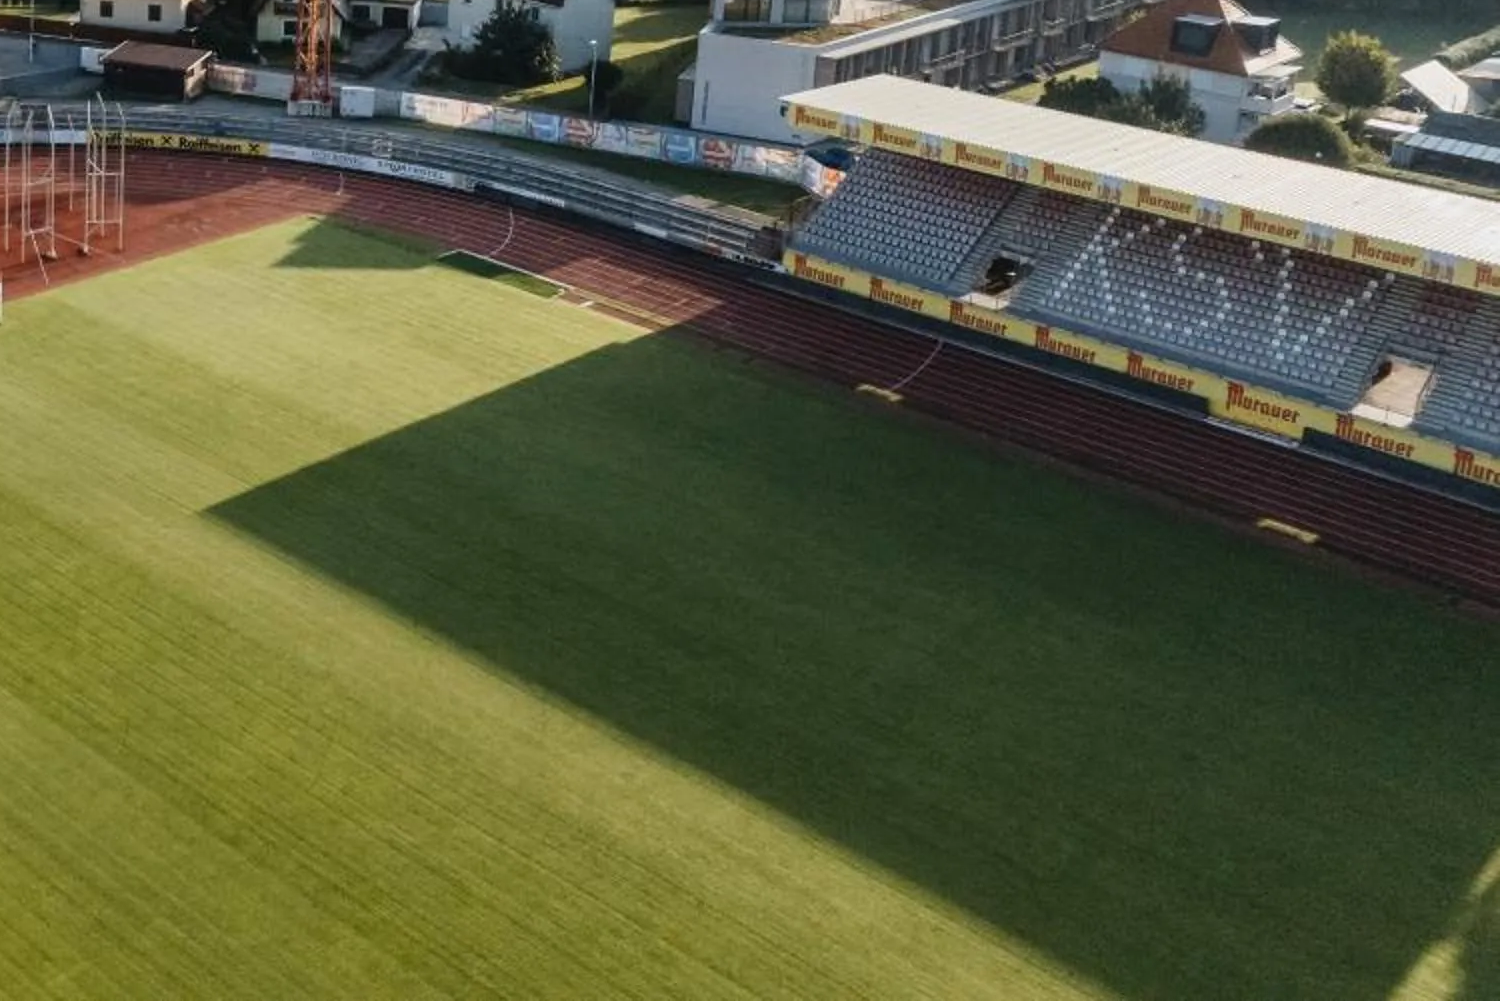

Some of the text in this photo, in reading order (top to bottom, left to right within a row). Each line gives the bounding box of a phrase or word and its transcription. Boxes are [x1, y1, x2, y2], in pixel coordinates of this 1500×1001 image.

[1137, 181, 1192, 215] Murauer
[1240, 207, 1300, 240] Murauer
[1351, 232, 1416, 268] Murauer
[950, 300, 1007, 336] Murauer
[1035, 325, 1096, 364] Murauer
[1126, 350, 1195, 391] Murauer
[1226, 380, 1300, 423] Murauer
[1336, 412, 1414, 457] Murauer
